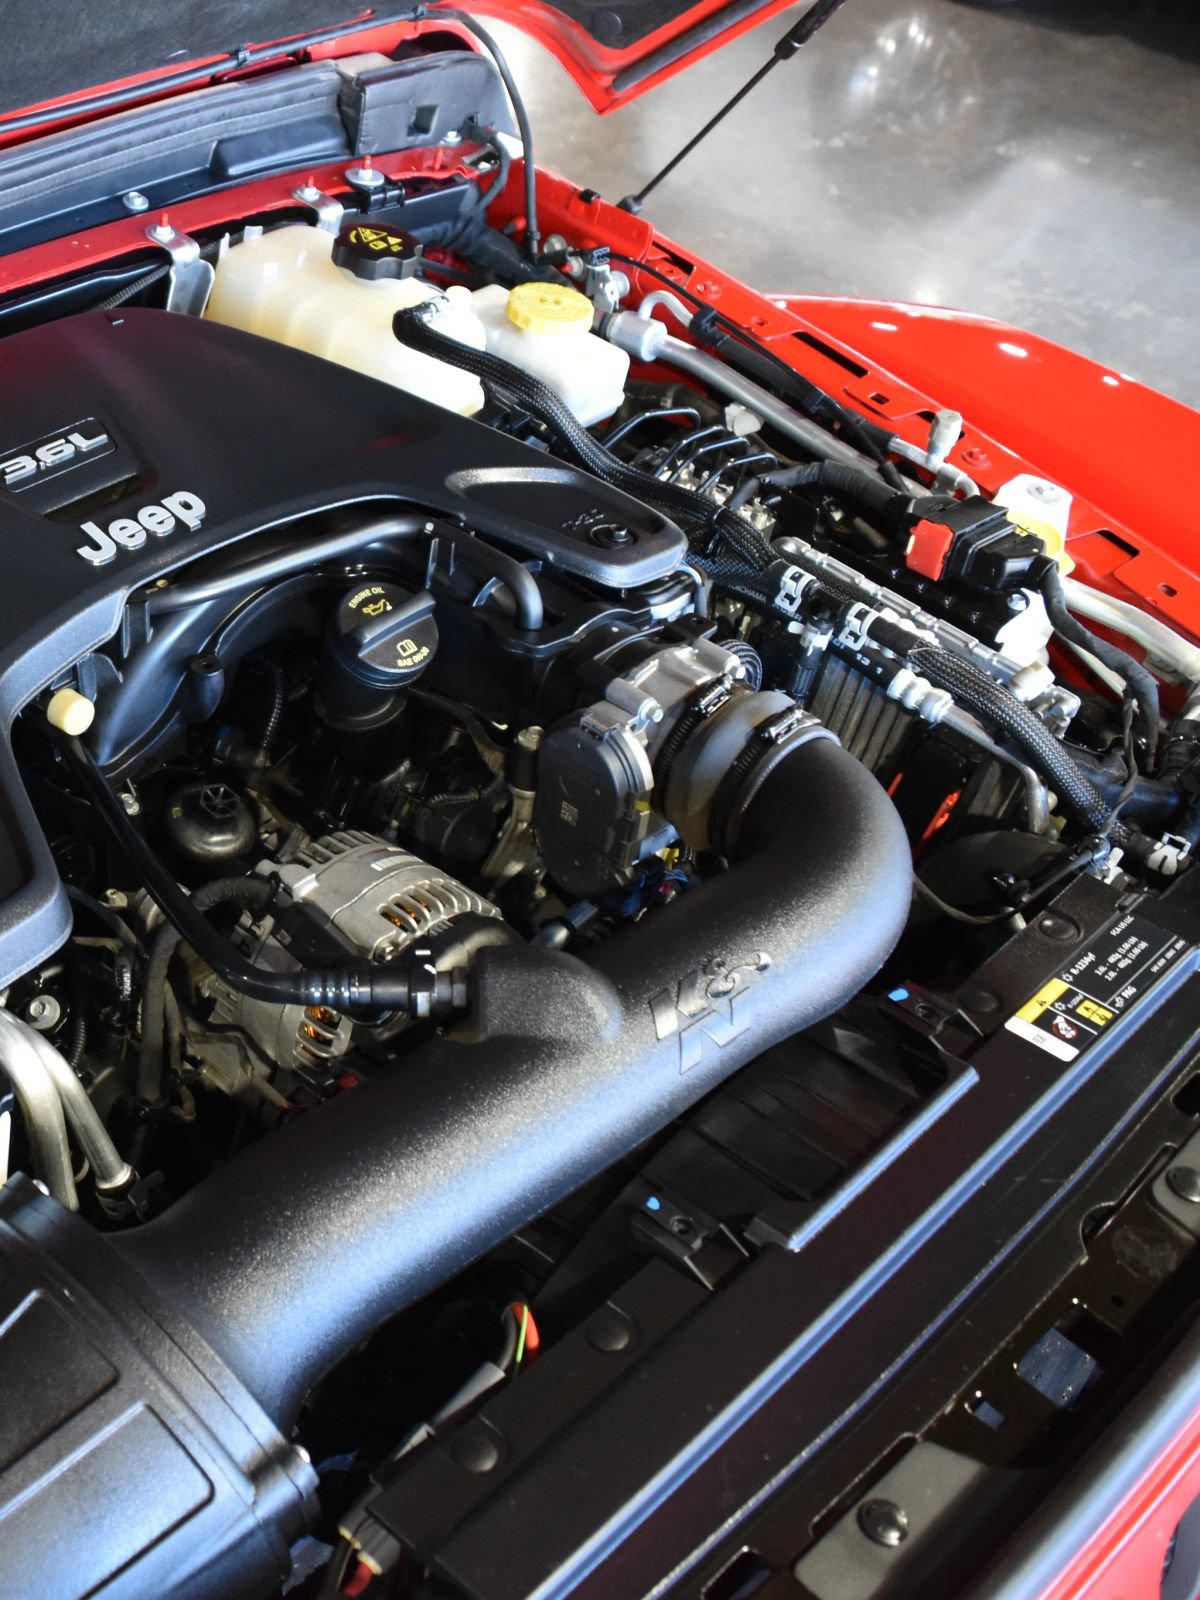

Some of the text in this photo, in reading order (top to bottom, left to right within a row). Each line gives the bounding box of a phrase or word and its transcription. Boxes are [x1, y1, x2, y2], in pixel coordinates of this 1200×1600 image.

[76, 491, 206, 566] Jeep
[348, 586, 386, 609] ENGINE OIL
[1110, 915, 1135, 936] FCA US LLC
[1121, 986, 1137, 998] PAG
